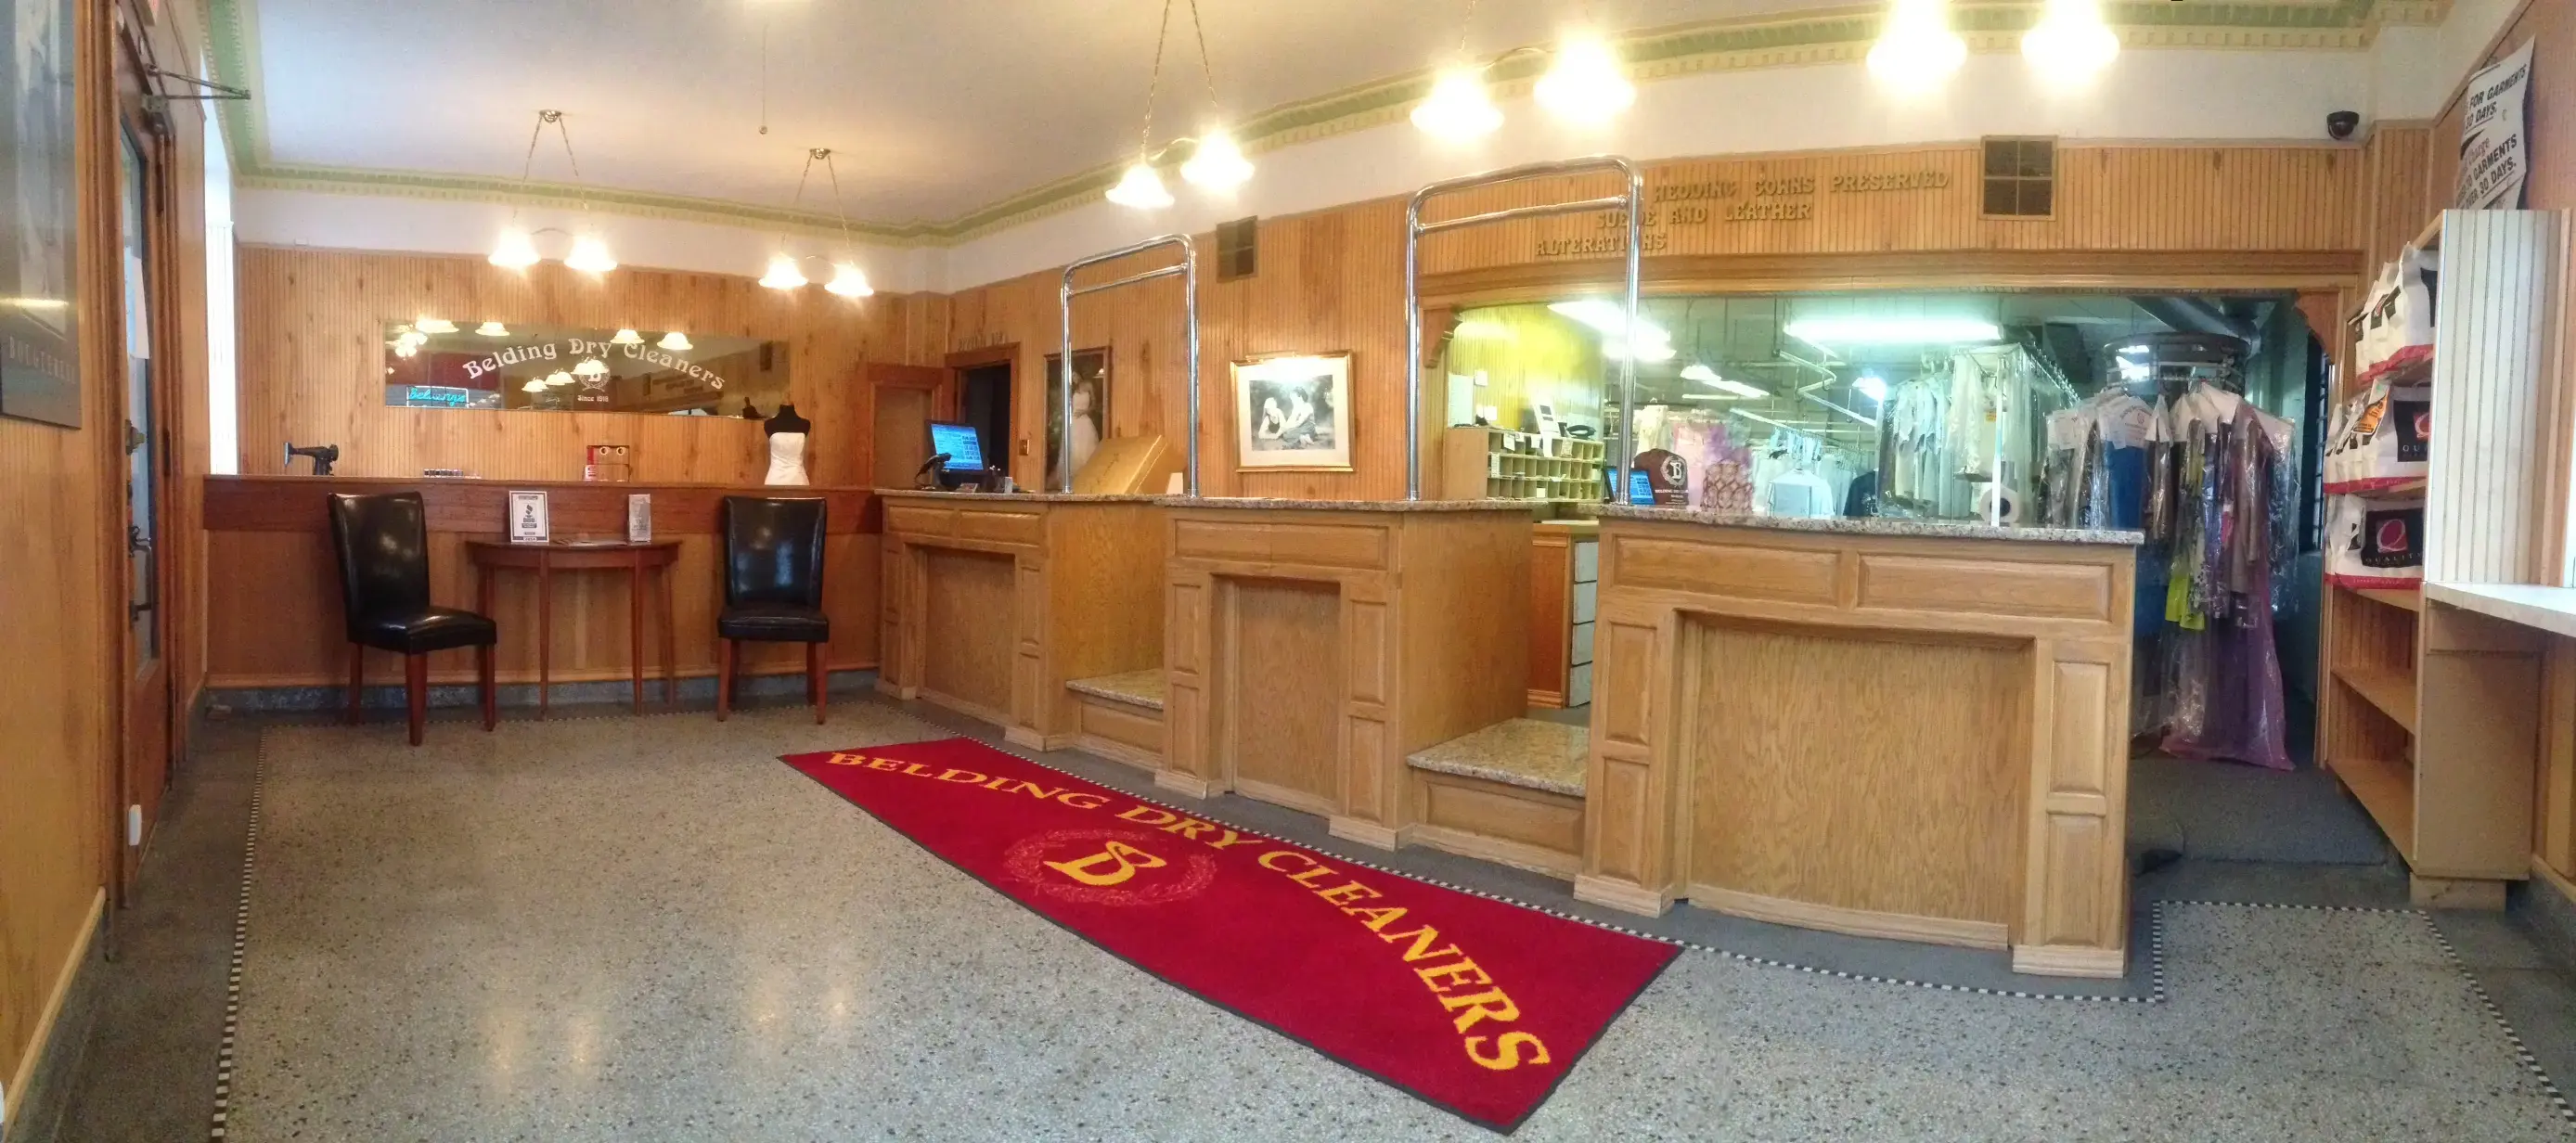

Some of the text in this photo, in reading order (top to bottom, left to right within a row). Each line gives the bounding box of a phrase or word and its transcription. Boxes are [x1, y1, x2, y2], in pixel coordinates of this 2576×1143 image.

[2469, 64, 2527, 110] FOR GARMENTS
[2475, 101, 2497, 122] DAYS.
[2473, 133, 2518, 181] GARMENTS
[1755, 175, 1816, 196] GOWNS
[1830, 169, 1950, 193] PRESERVED
[2479, 176, 2489, 195] 30
[2491, 156, 2517, 184] DAYS.
[1596, 200, 1811, 229] SUEE AND LEATHER
[1536, 233, 1668, 256] ALTERATINS
[462, 342, 557, 379] Belding
[568, 338, 612, 359] Dry
[624, 342, 726, 390] Cleaners
[1669, 461, 1682, 480] B
[825, 751, 1551, 1071] BELDING DRY CLEANERS
